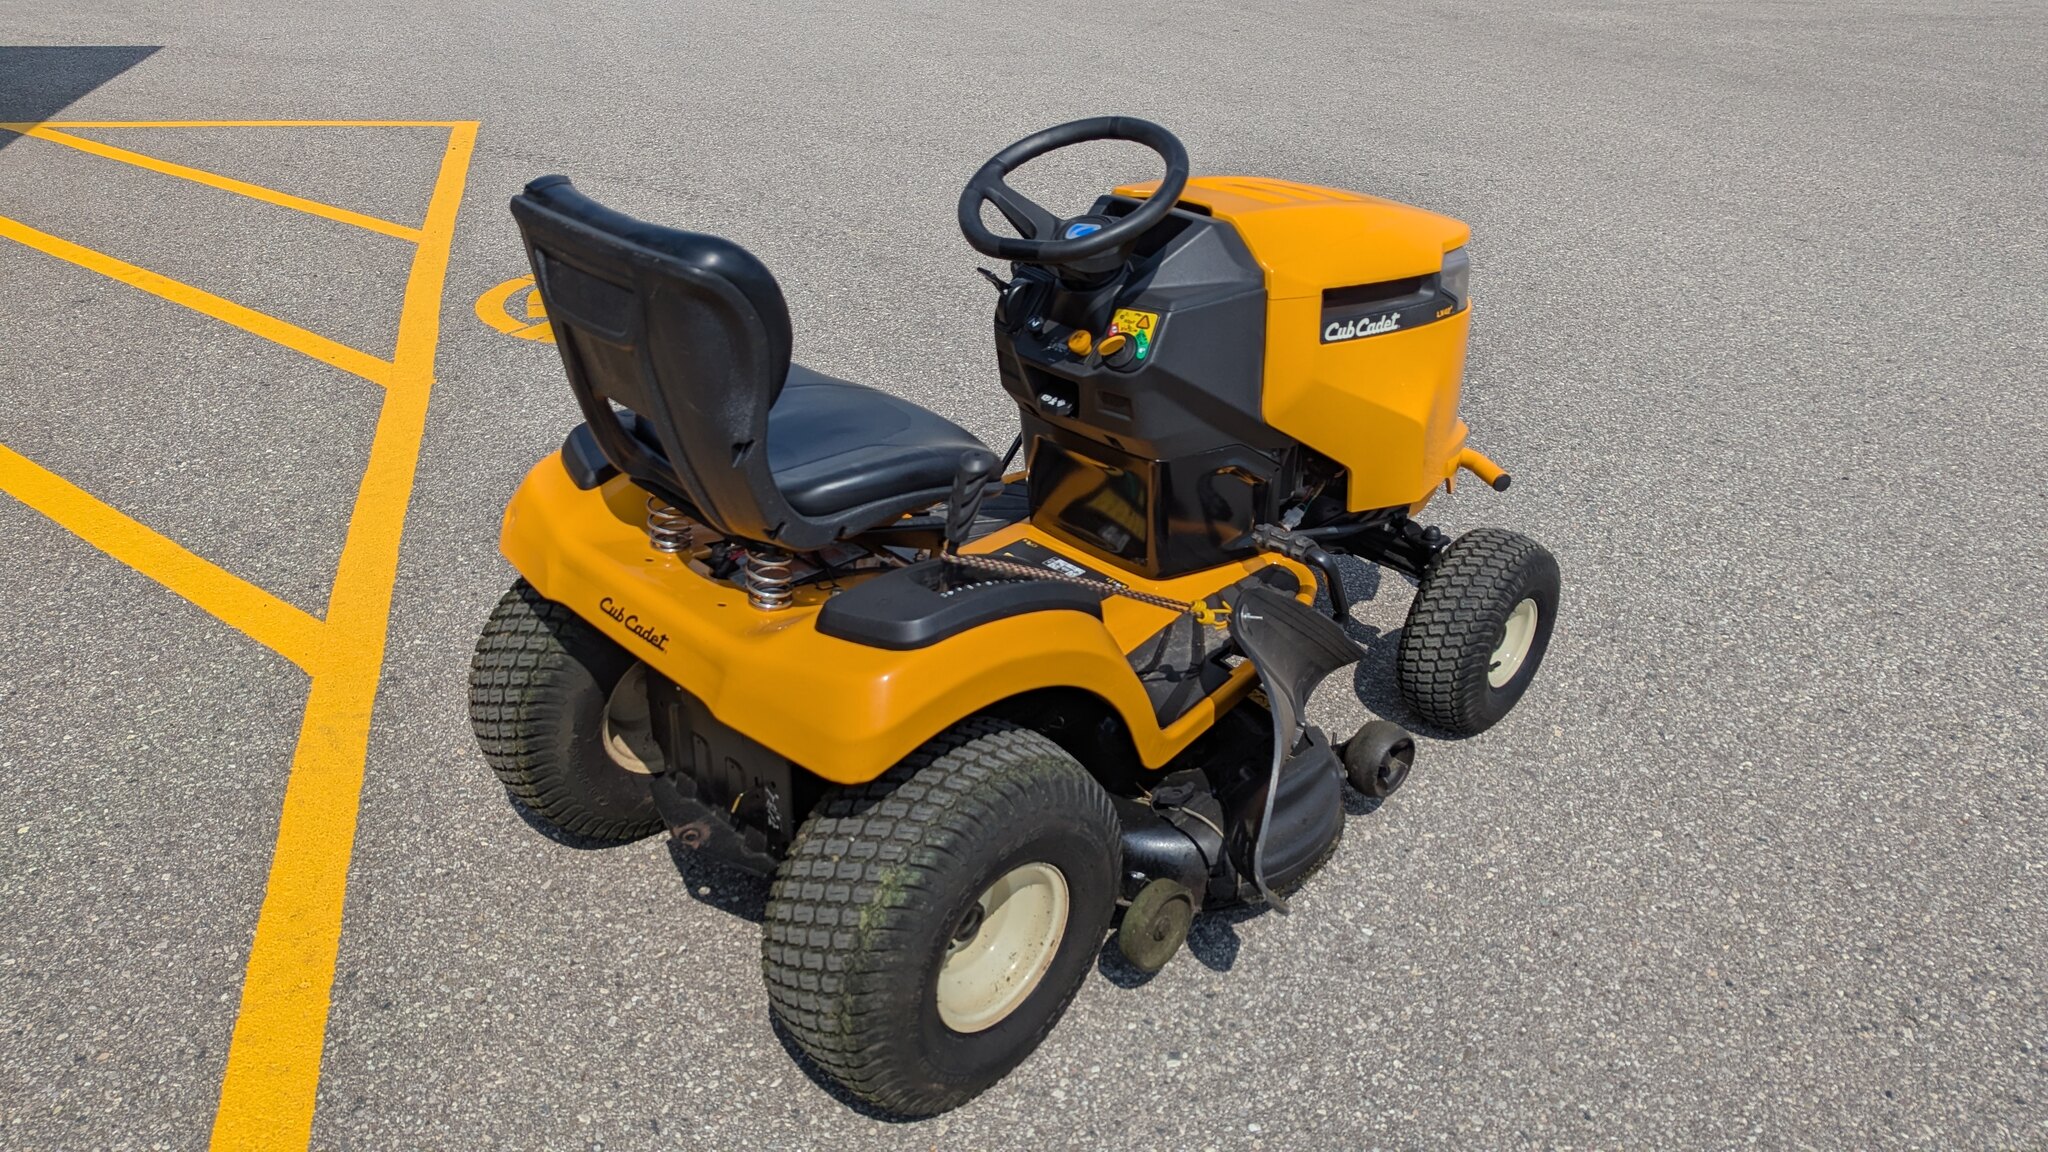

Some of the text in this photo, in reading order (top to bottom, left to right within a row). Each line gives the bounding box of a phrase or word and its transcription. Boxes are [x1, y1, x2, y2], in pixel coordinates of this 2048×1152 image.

[1324, 312, 1401, 341] Cub Cadet
[599, 596, 669, 652] Cub Cadet
